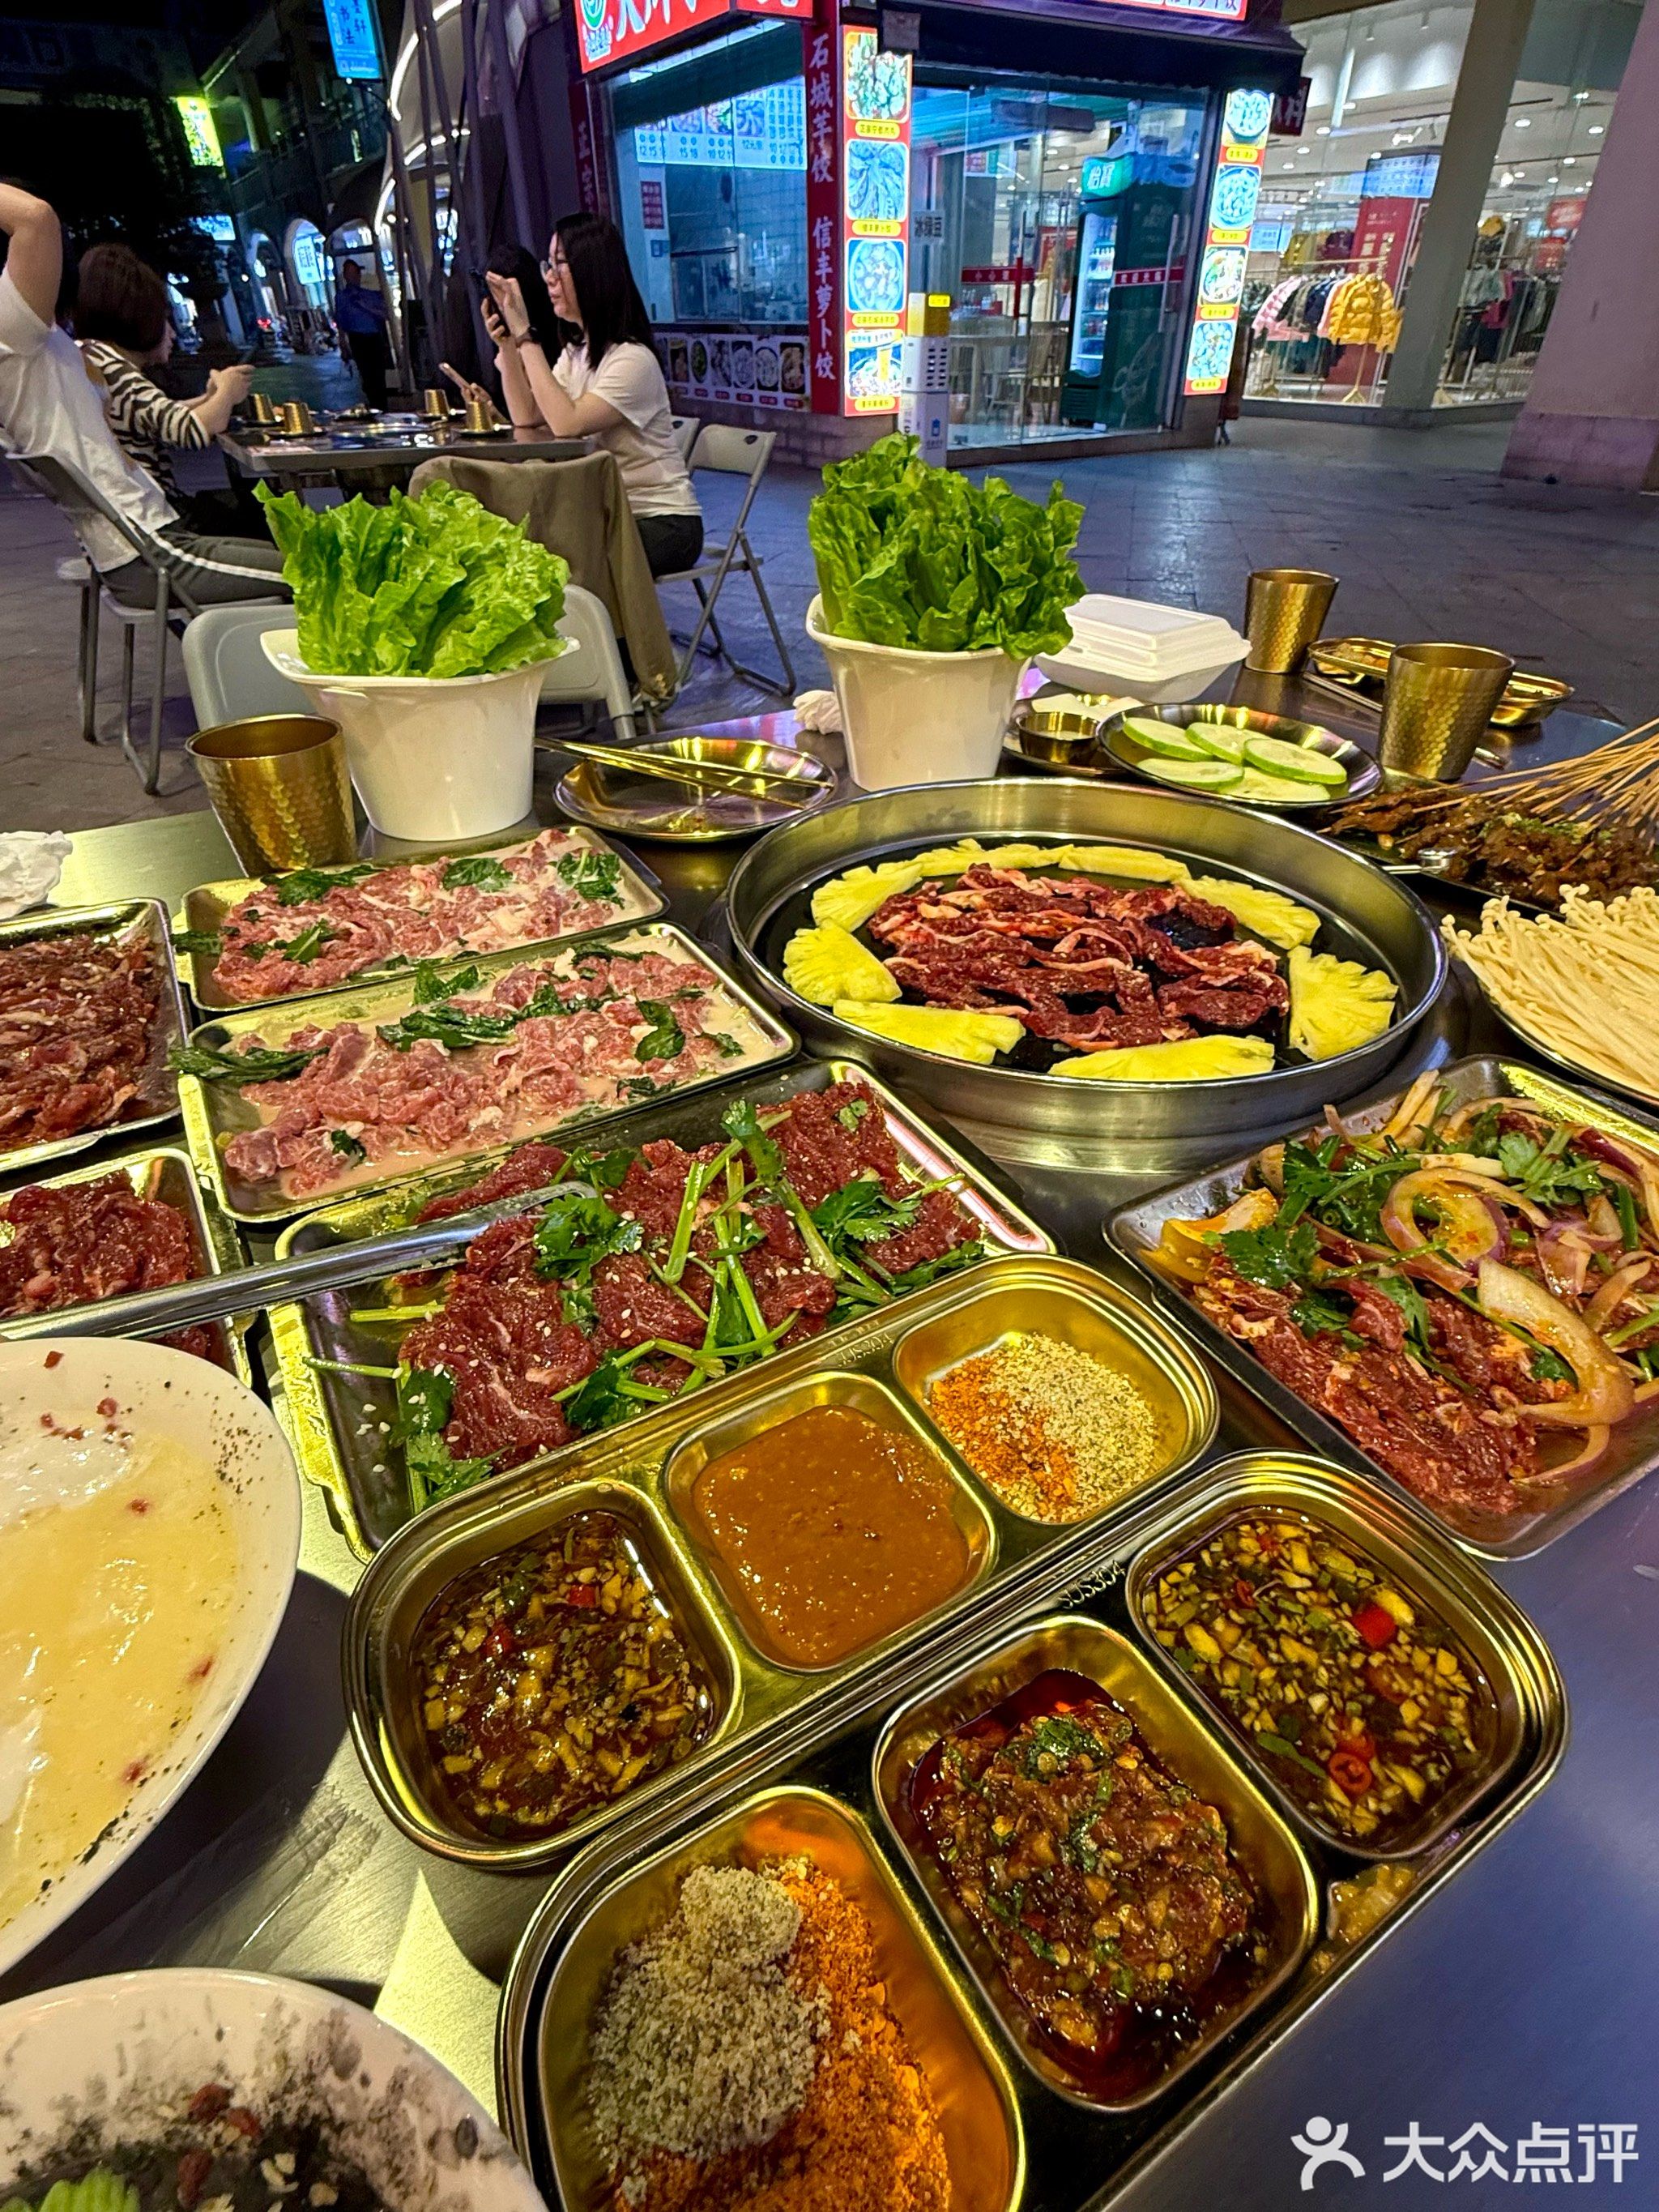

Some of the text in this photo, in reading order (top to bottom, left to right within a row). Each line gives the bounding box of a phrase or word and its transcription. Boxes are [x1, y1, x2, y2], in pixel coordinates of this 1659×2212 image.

[809, 33, 837, 381] 石城芋饺 信丰萝卜饺
[1057, 1559, 1126, 1610] SUS304
